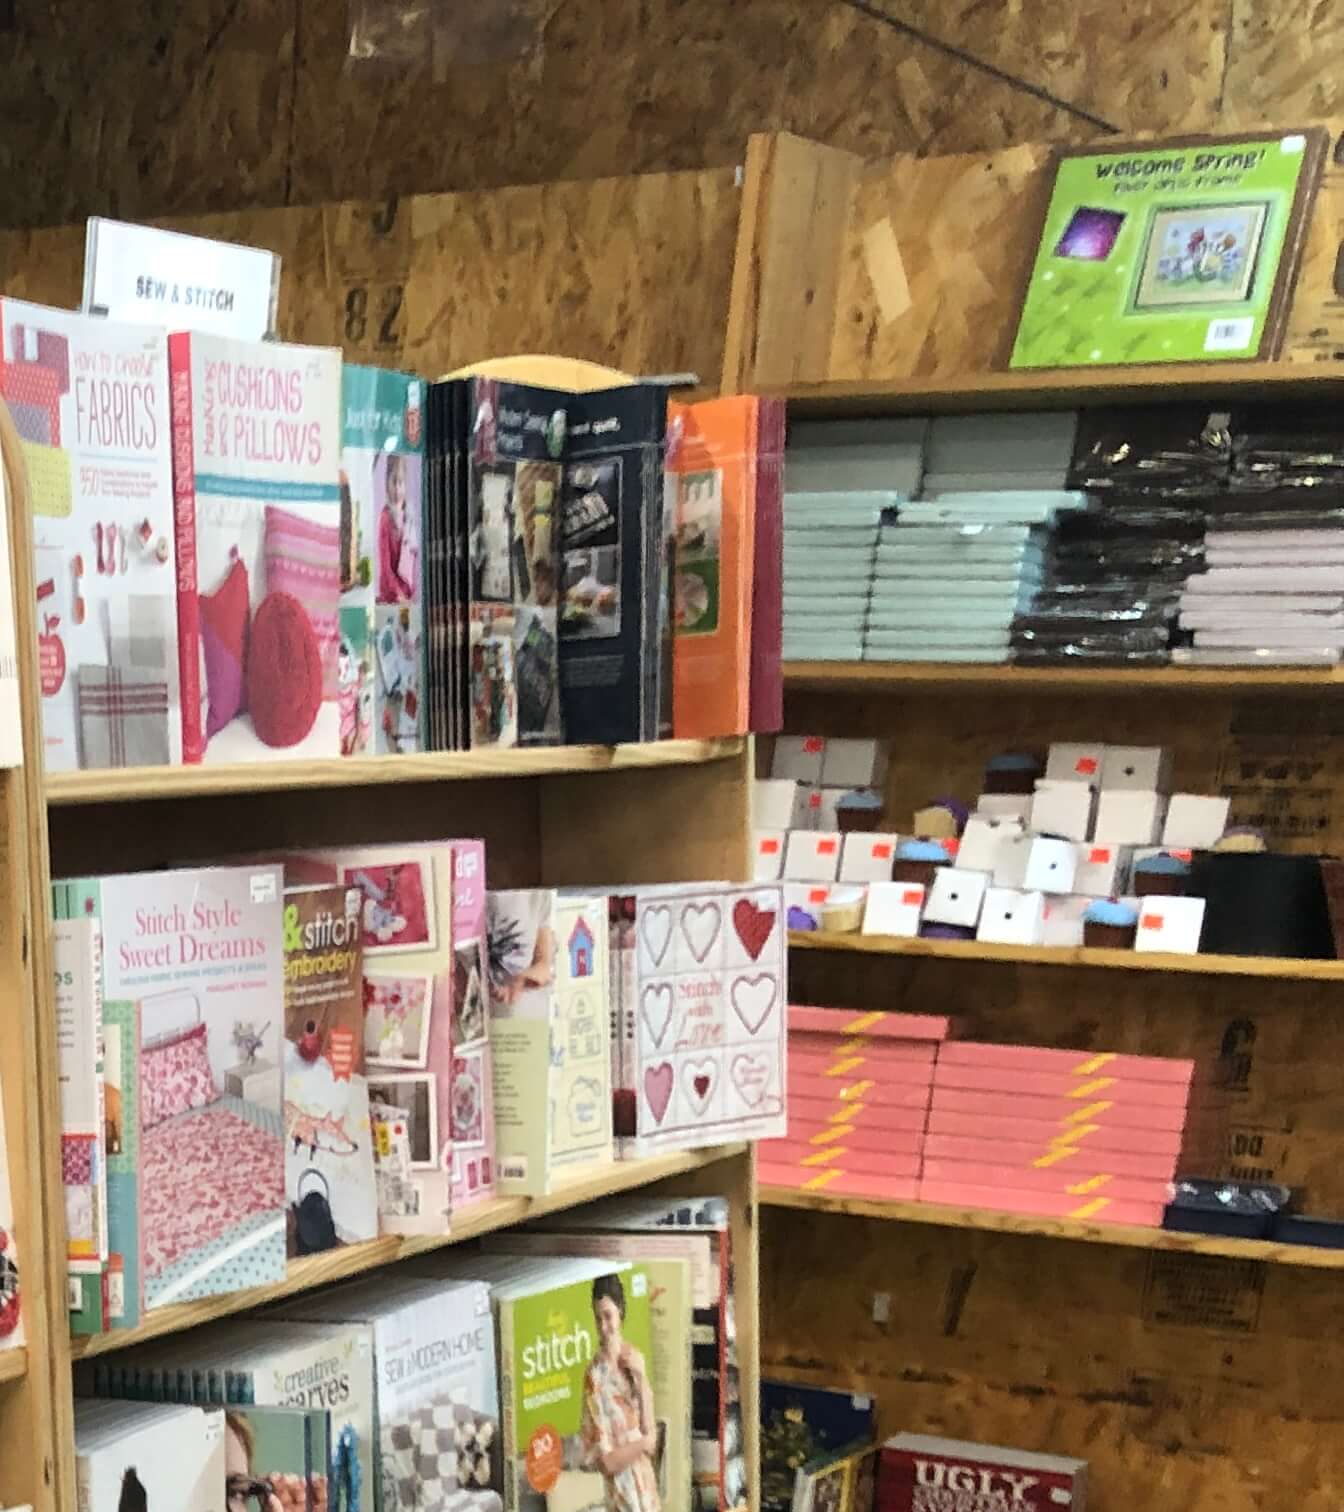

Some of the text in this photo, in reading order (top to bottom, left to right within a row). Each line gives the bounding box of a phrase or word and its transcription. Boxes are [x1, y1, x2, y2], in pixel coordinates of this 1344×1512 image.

[135, 275, 234, 311] SEW & STITCH
[75, 375, 157, 451] FABRICS
[135, 898, 241, 938] Stitch Style
[284, 903, 359, 952] & stitch
[120, 933, 266, 971] Sweet Dreams
[522, 1322, 592, 1379] stitch
[283, 1353, 340, 1392] creative
[915, 1460, 1039, 1502] UGLY
